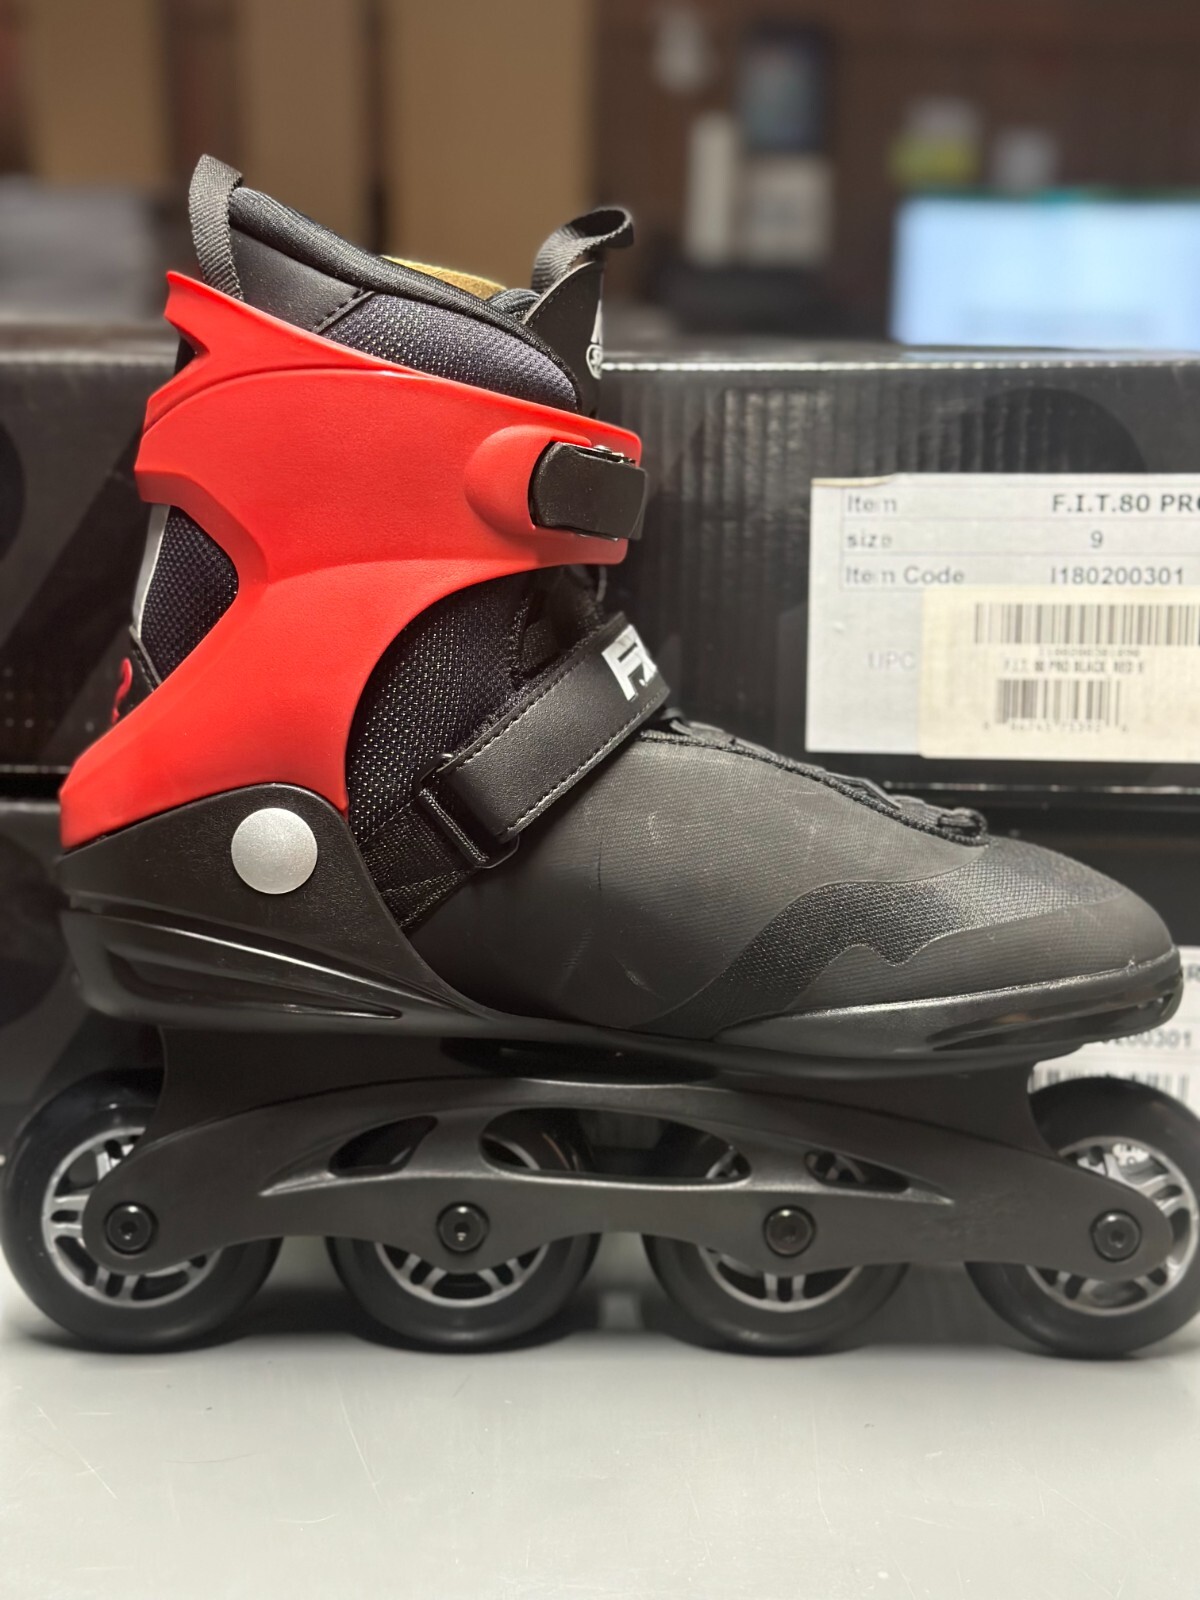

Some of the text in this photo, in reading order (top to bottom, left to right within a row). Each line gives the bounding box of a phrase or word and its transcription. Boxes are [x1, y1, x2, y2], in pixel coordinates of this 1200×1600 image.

[1052, 493, 1151, 513] F.I.T.80
[846, 531, 893, 548] size
[1090, 530, 1104, 549] 9
[903, 565, 965, 585] Code
[868, 652, 917, 670] UPC
